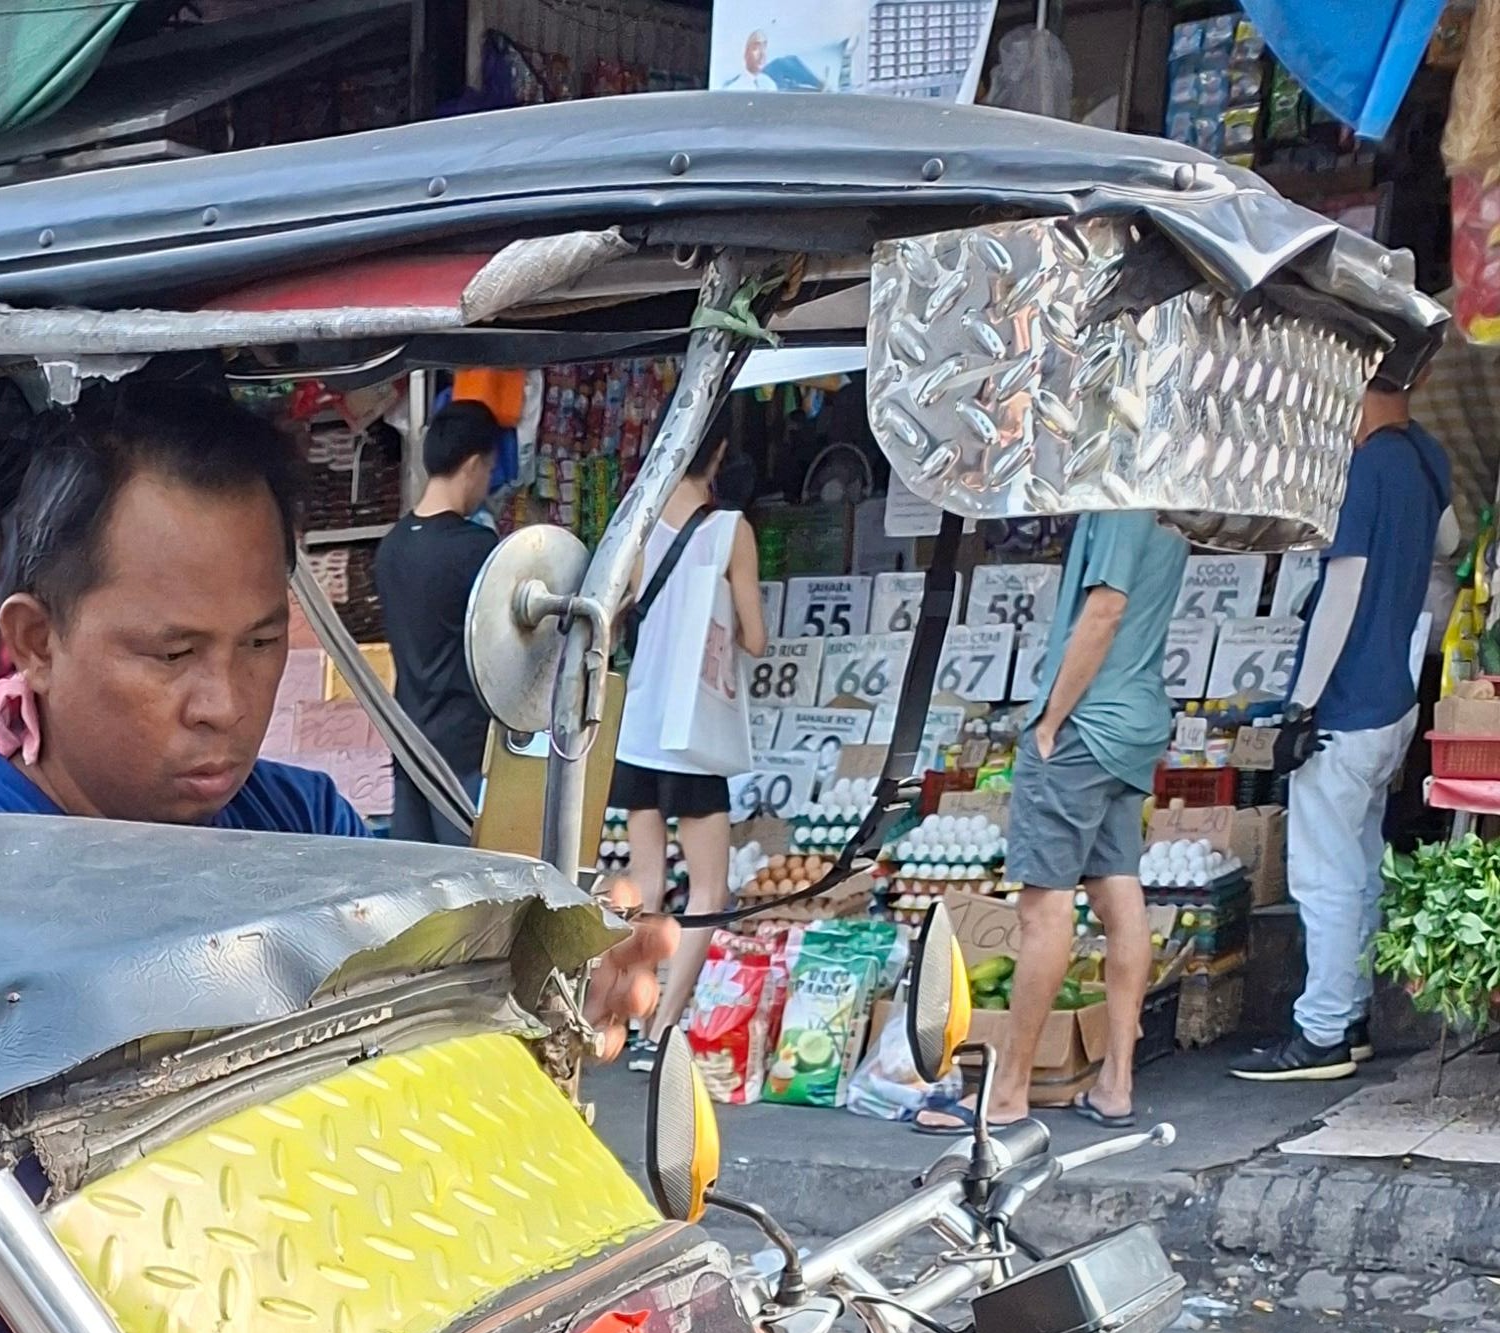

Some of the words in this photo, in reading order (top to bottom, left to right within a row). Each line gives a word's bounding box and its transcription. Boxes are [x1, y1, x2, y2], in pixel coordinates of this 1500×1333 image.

[1184, 575, 1240, 588] PANDAN
[1196, 562, 1236, 576] COCO
[800, 603, 852, 637] 55
[984, 592, 1036, 632] 58
[750, 662, 799, 699] 88
[833, 658, 888, 697] 66
[936, 654, 996, 693] 67
[1232, 649, 1294, 692] 65
[738, 772, 793, 811] 60
